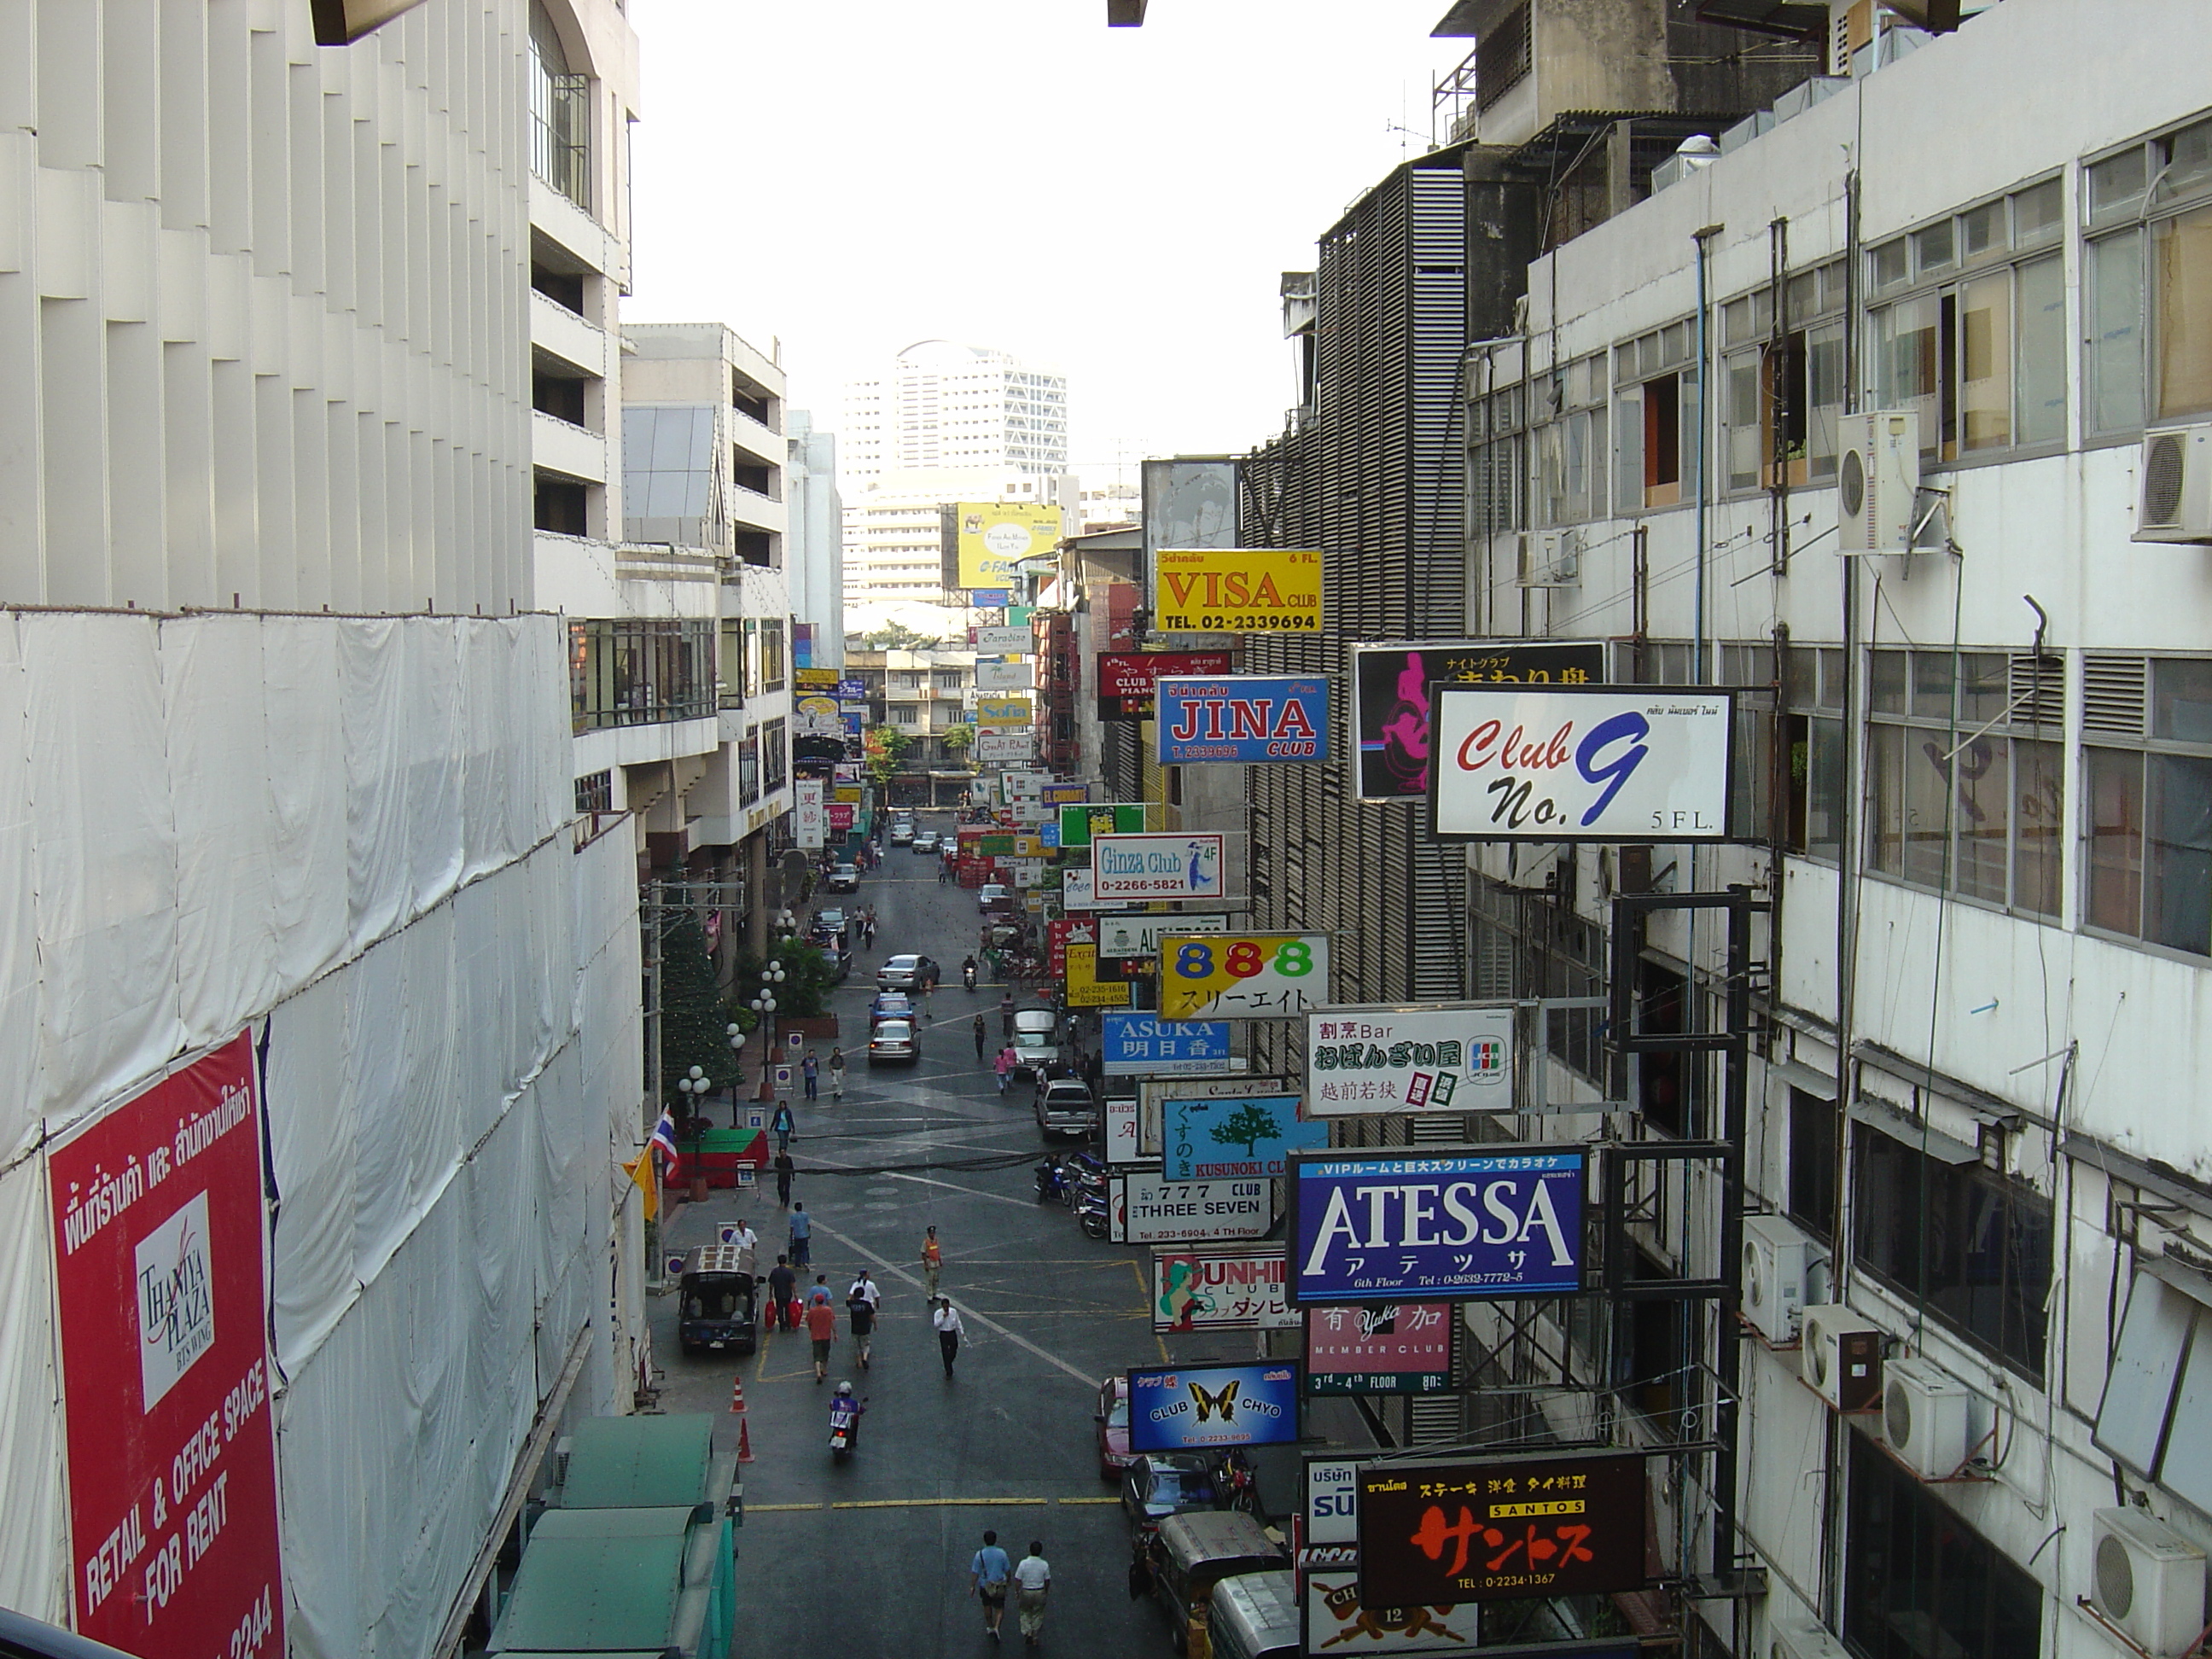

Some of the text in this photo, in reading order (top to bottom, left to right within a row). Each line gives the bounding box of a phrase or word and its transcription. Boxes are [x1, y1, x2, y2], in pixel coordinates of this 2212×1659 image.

[1289, 554, 1318, 563] 6 FL.
[1163, 572, 1285, 608] VISA
[1288, 594, 1317, 608] CLUB
[1166, 615, 1315, 629] TEL. 02-2339694
[1447, 656, 1510, 669] ナイトクラブ
[1115, 678, 1146, 687] CLUB
[983, 703, 1027, 718] Sofia
[1647, 704, 1720, 715] คลับ นัมเบอร์ ไนน์
[1171, 699, 1316, 742] JINA
[1172, 745, 1237, 759] T. 2339696
[1267, 741, 1316, 756] CLUB
[1457, 719, 1574, 771] Club
[1575, 711, 1650, 827] 9
[1487, 776, 1567, 829] No.
[1651, 811, 1662, 828] 5
[1102, 846, 1181, 874] Ginza Club
[1204, 847, 1217, 861] 4F
[1102, 879, 1184, 891] 0-2266-5821
[1180, 988, 1307, 1013] スリーエイト
[1120, 1021, 1214, 1038] ASUKA
[1123, 1039, 1209, 1057] 明日香
[1314, 1040, 1461, 1070] おばんざい屋
[1175, 1105, 1194, 1177] くすのき
[64, 1077, 251, 1256] พื้นที่ร้านค้า และ สำนักงานให้เช่า
[1196, 1161, 1287, 1177] KUSUNOKI CL
[1232, 1184, 1260, 1196] CLUB
[1140, 1201, 1260, 1218] THREE SEVEN
[1237, 1227, 1260, 1236] Floor
[1303, 1179, 1575, 1276] ATESSA
[140, 1247, 205, 1331] THANIYA
[1205, 1284, 1278, 1295] CLUB
[1354, 1278, 1373, 1289] 6th
[1376, 1278, 1403, 1288] Floor
[166, 1281, 210, 1353] PLAZA
[1354, 1305, 1401, 1342] Yuka
[176, 1321, 212, 1371] BTS WING
[1398, 1345, 1444, 1353] CLUB
[1315, 1374, 1333, 1389] 3rd
[1345, 1374, 1363, 1388] 4th
[1370, 1376, 1396, 1388] FLOOR
[1150, 1400, 1189, 1422] CLUB
[1242, 1398, 1282, 1417] CHYO
[1313, 1467, 1352, 1483] บริษัท
[86, 1358, 265, 1616] RETAIL & OFFICE SPACE
[1420, 1475, 1586, 1499] ステーキ 洋食 タイ料理
[1493, 1503, 1582, 1516] SANTOS
[145, 1470, 228, 1626] FOR RENT
[1411, 1505, 1593, 1577] サントス
[1386, 1608, 1402, 1622] 12
